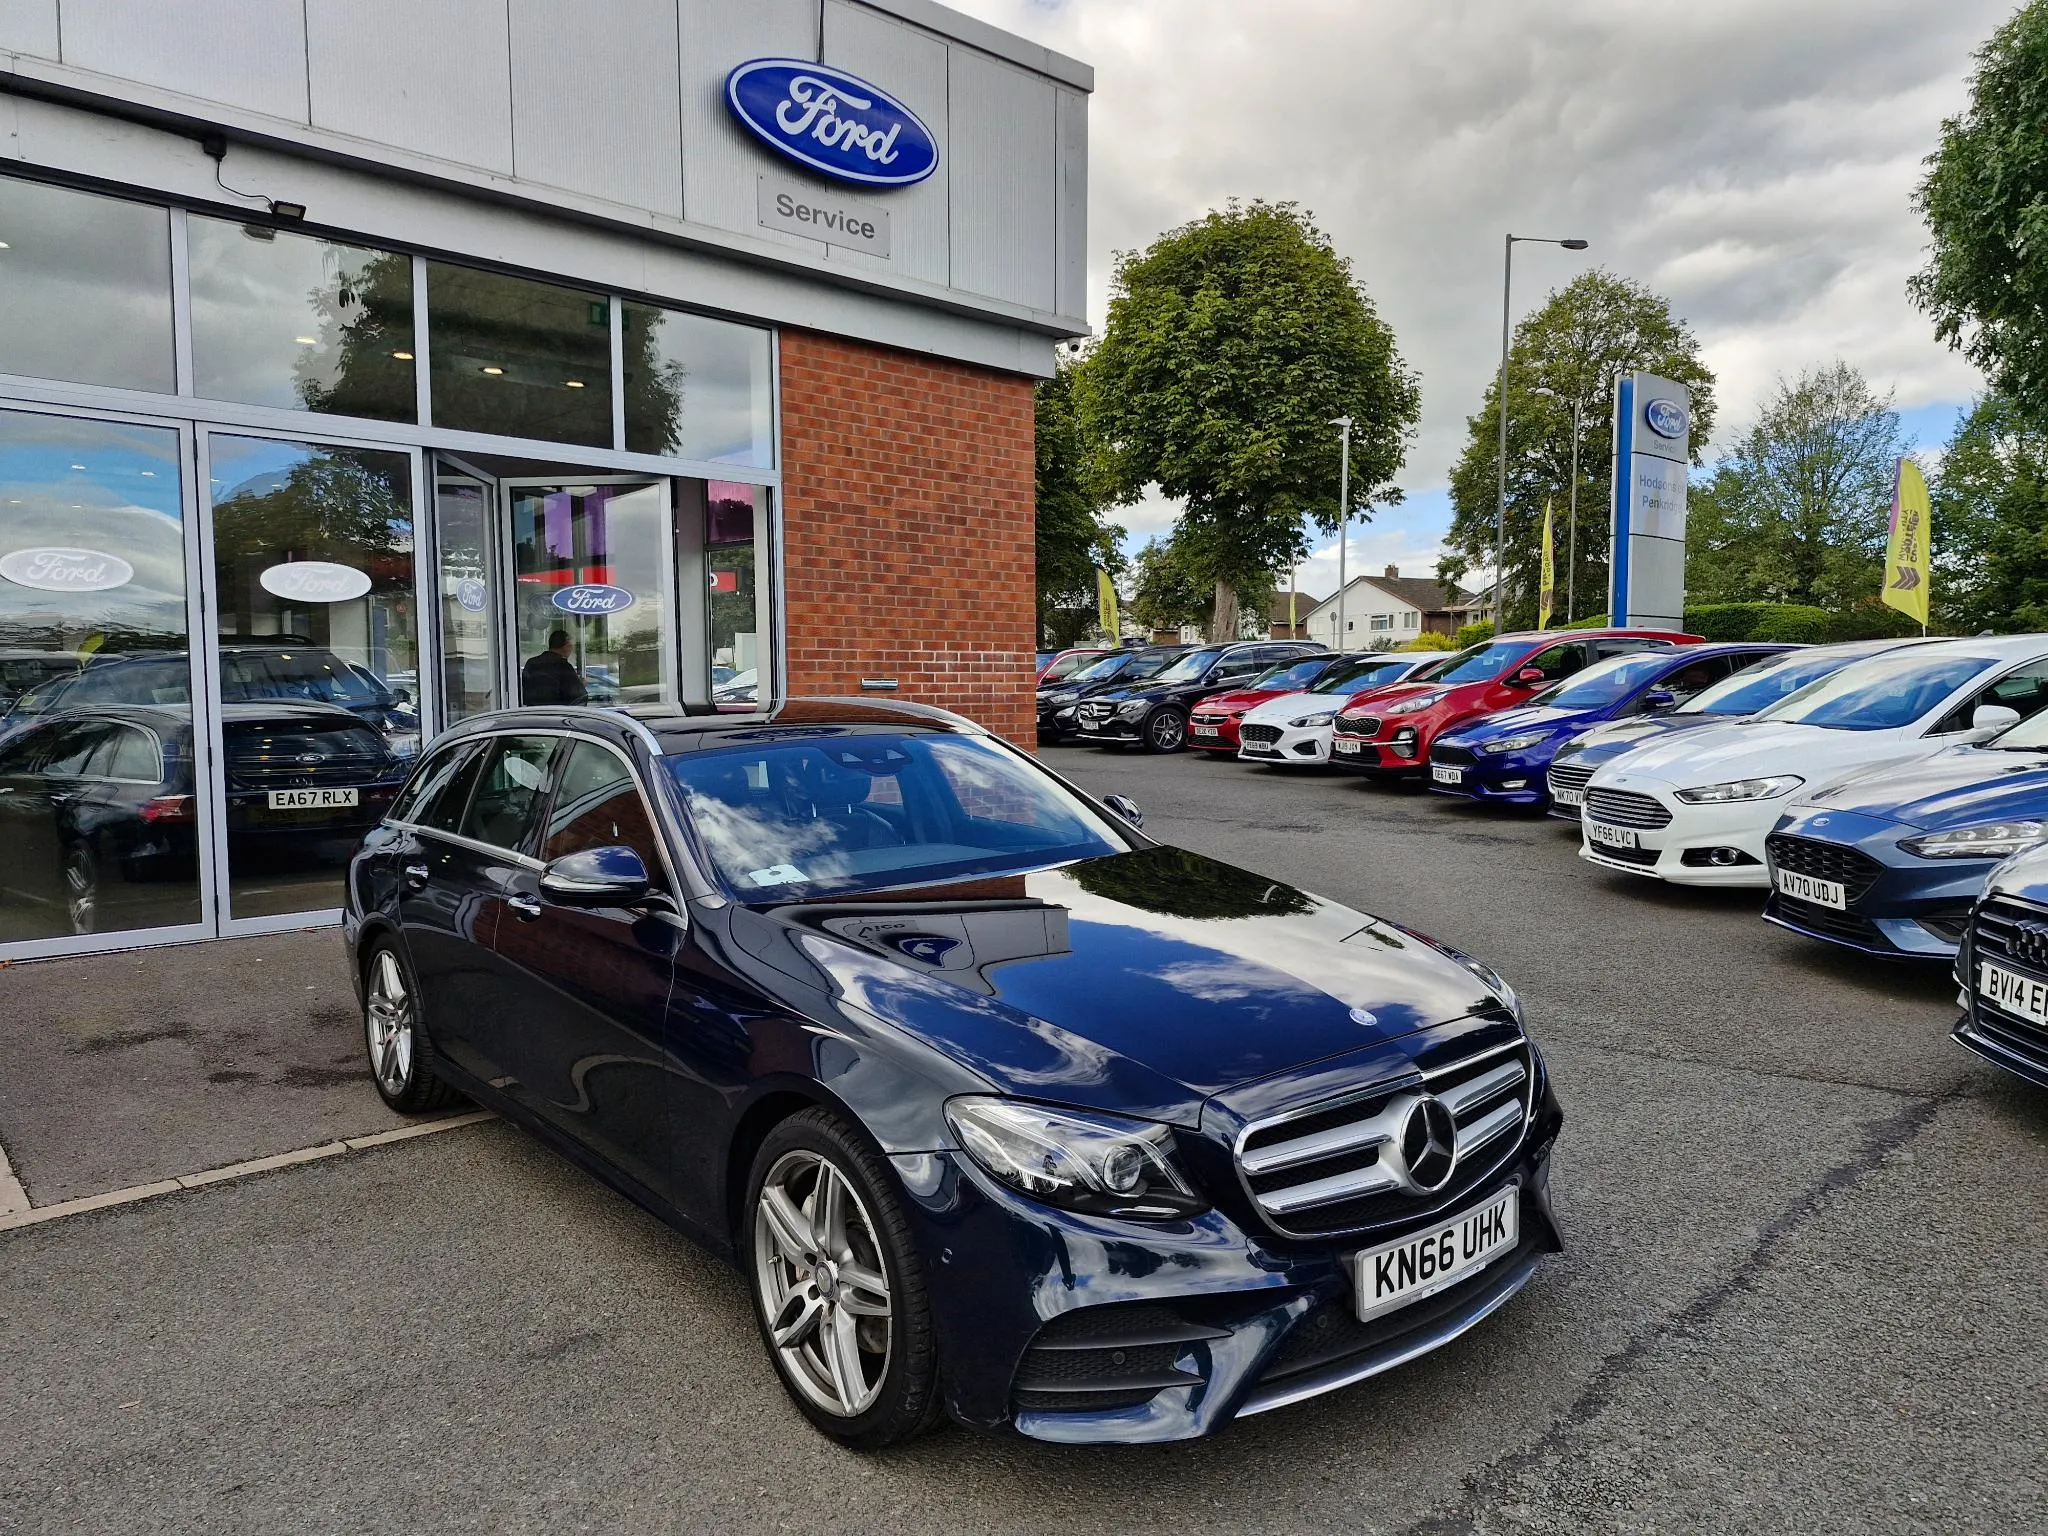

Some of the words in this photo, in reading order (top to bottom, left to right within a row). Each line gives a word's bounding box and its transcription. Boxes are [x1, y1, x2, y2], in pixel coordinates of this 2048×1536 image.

[776, 75, 902, 165] Ford
[776, 193, 875, 240] Service
[1657, 404, 1682, 432] Ford
[1653, 440, 1677, 453] Servic
[1639, 474, 1677, 493] Hodsons
[27, 552, 107, 582] Ford
[284, 567, 351, 594] Ford
[462, 583, 483, 608] Ford
[567, 588, 617, 610] Ford
[275, 792, 318, 806] EA67
[322, 790, 353, 805] RLX
[1557, 789, 1574, 802] NK70
[1592, 824, 1614, 841] YF66
[1614, 829, 1632, 845] LVC
[1783, 872, 1811, 897] AV70
[1812, 880, 1839, 904] UDJ
[1989, 968, 2025, 1008] BV14
[1375, 1229, 1455, 1299] KN66
[1463, 1200, 1507, 1261] UHK
